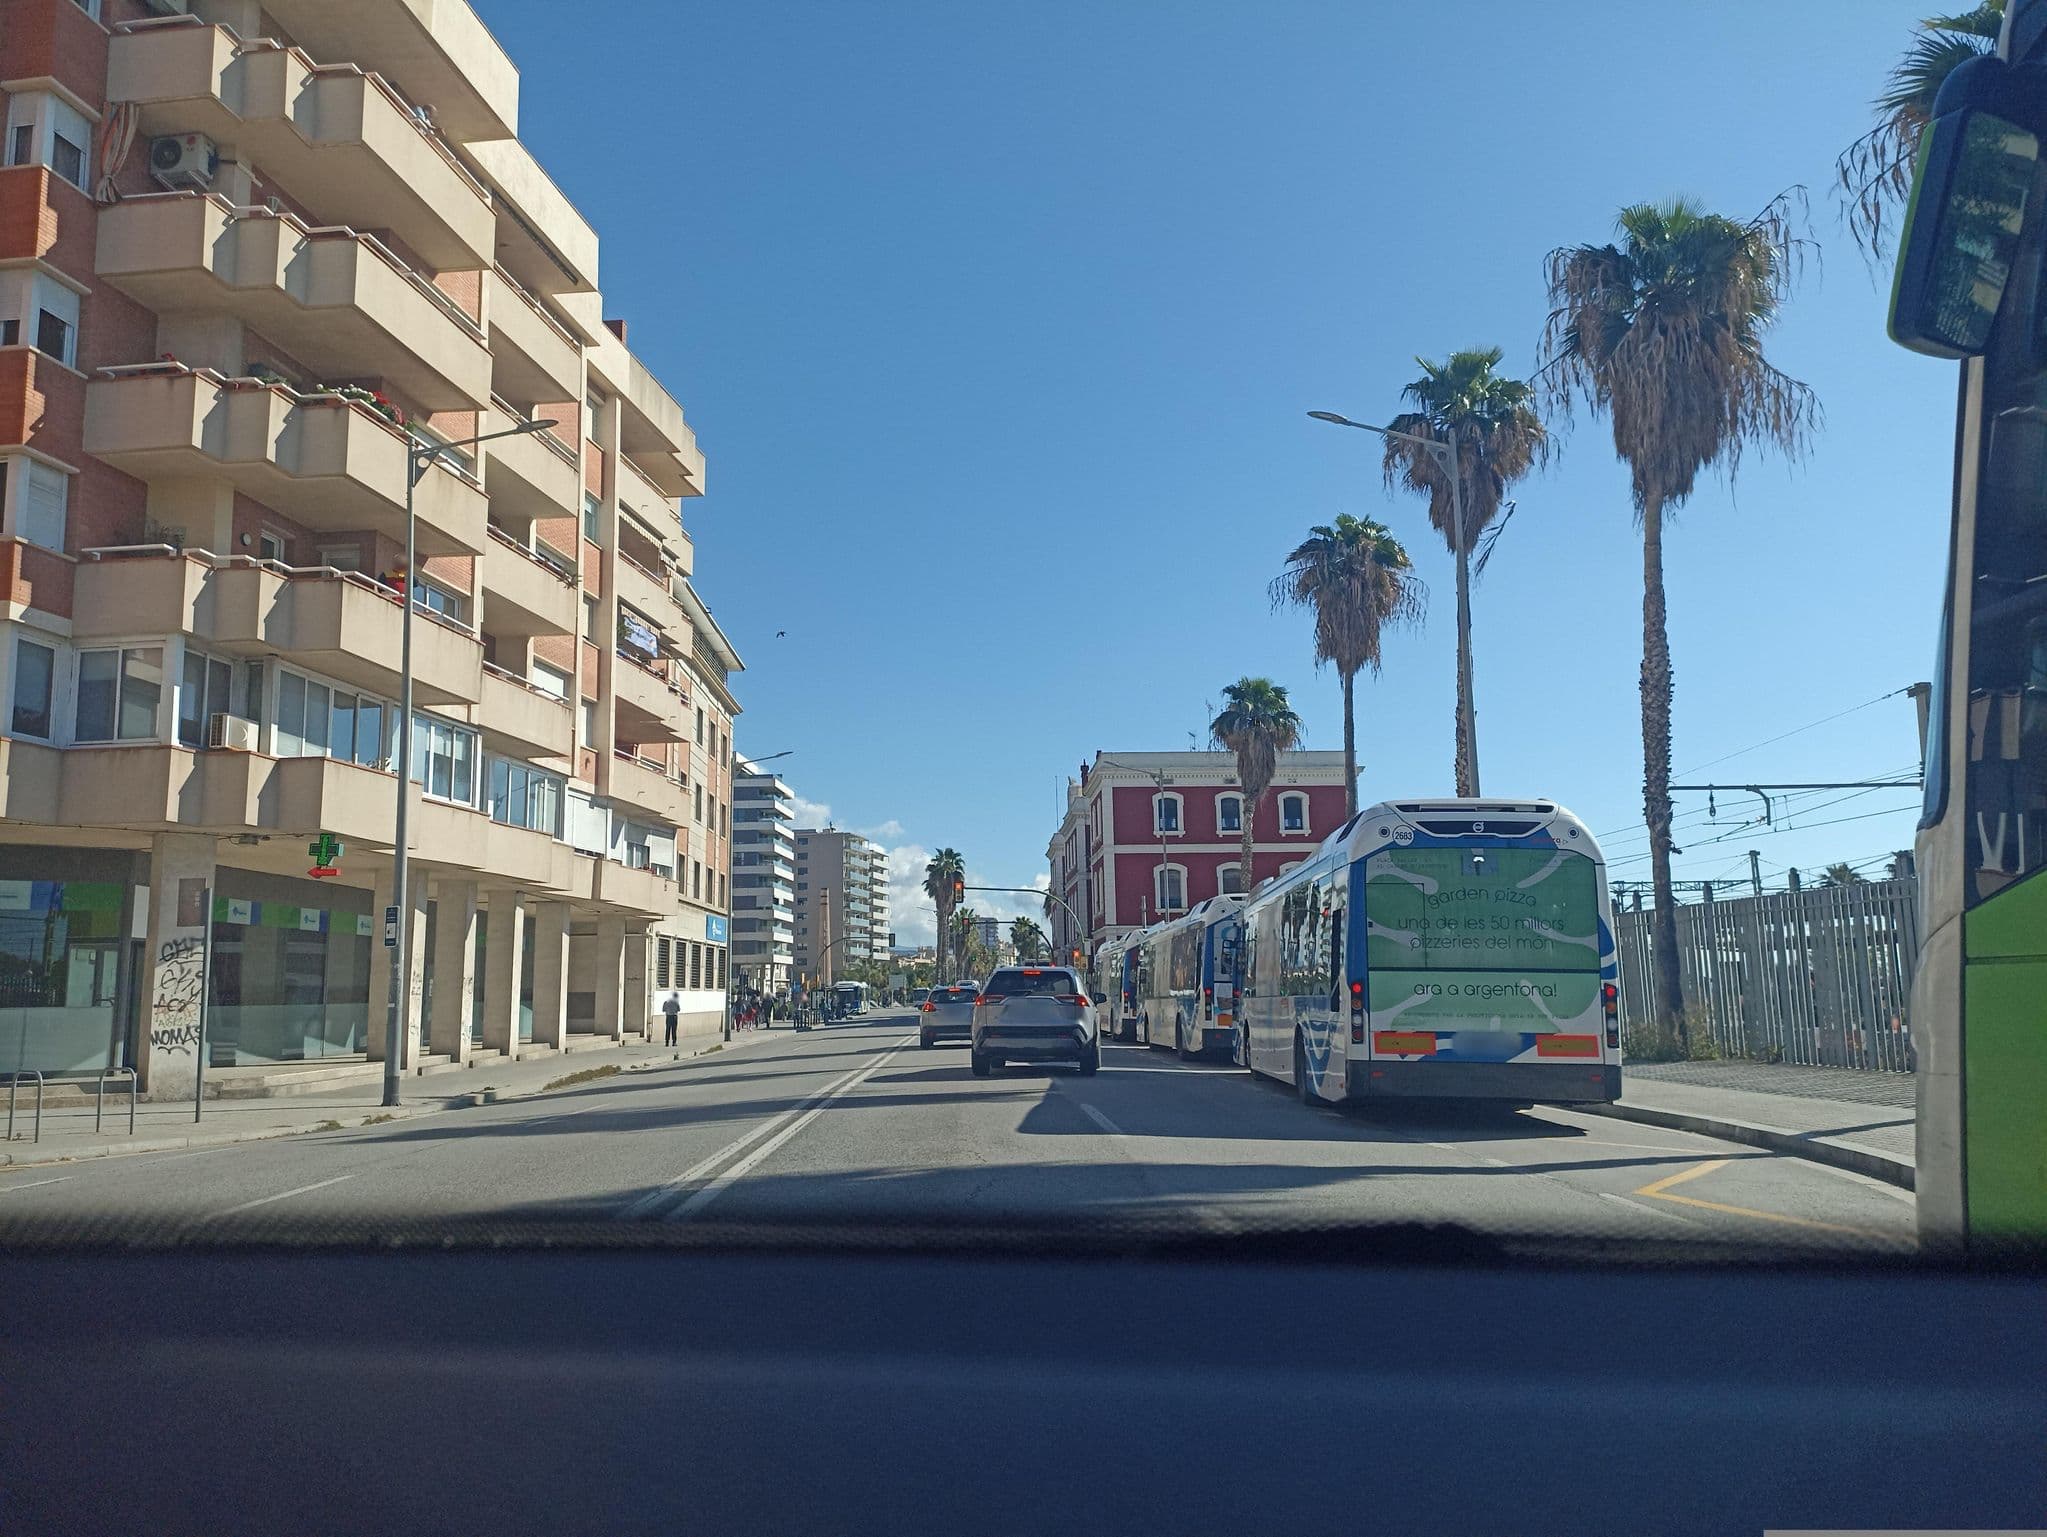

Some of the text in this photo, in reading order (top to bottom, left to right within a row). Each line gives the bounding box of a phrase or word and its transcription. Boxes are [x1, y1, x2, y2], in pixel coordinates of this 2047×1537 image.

[1394, 831, 1413, 841] 2683
[1428, 887, 1537, 910] garden pizza
[1398, 915, 1565, 931] una de les 50 millors
[1410, 934, 1480, 951] pizzeries
[1484, 935, 1512, 950] del
[1413, 982, 1558, 1000] ara a argentona!
